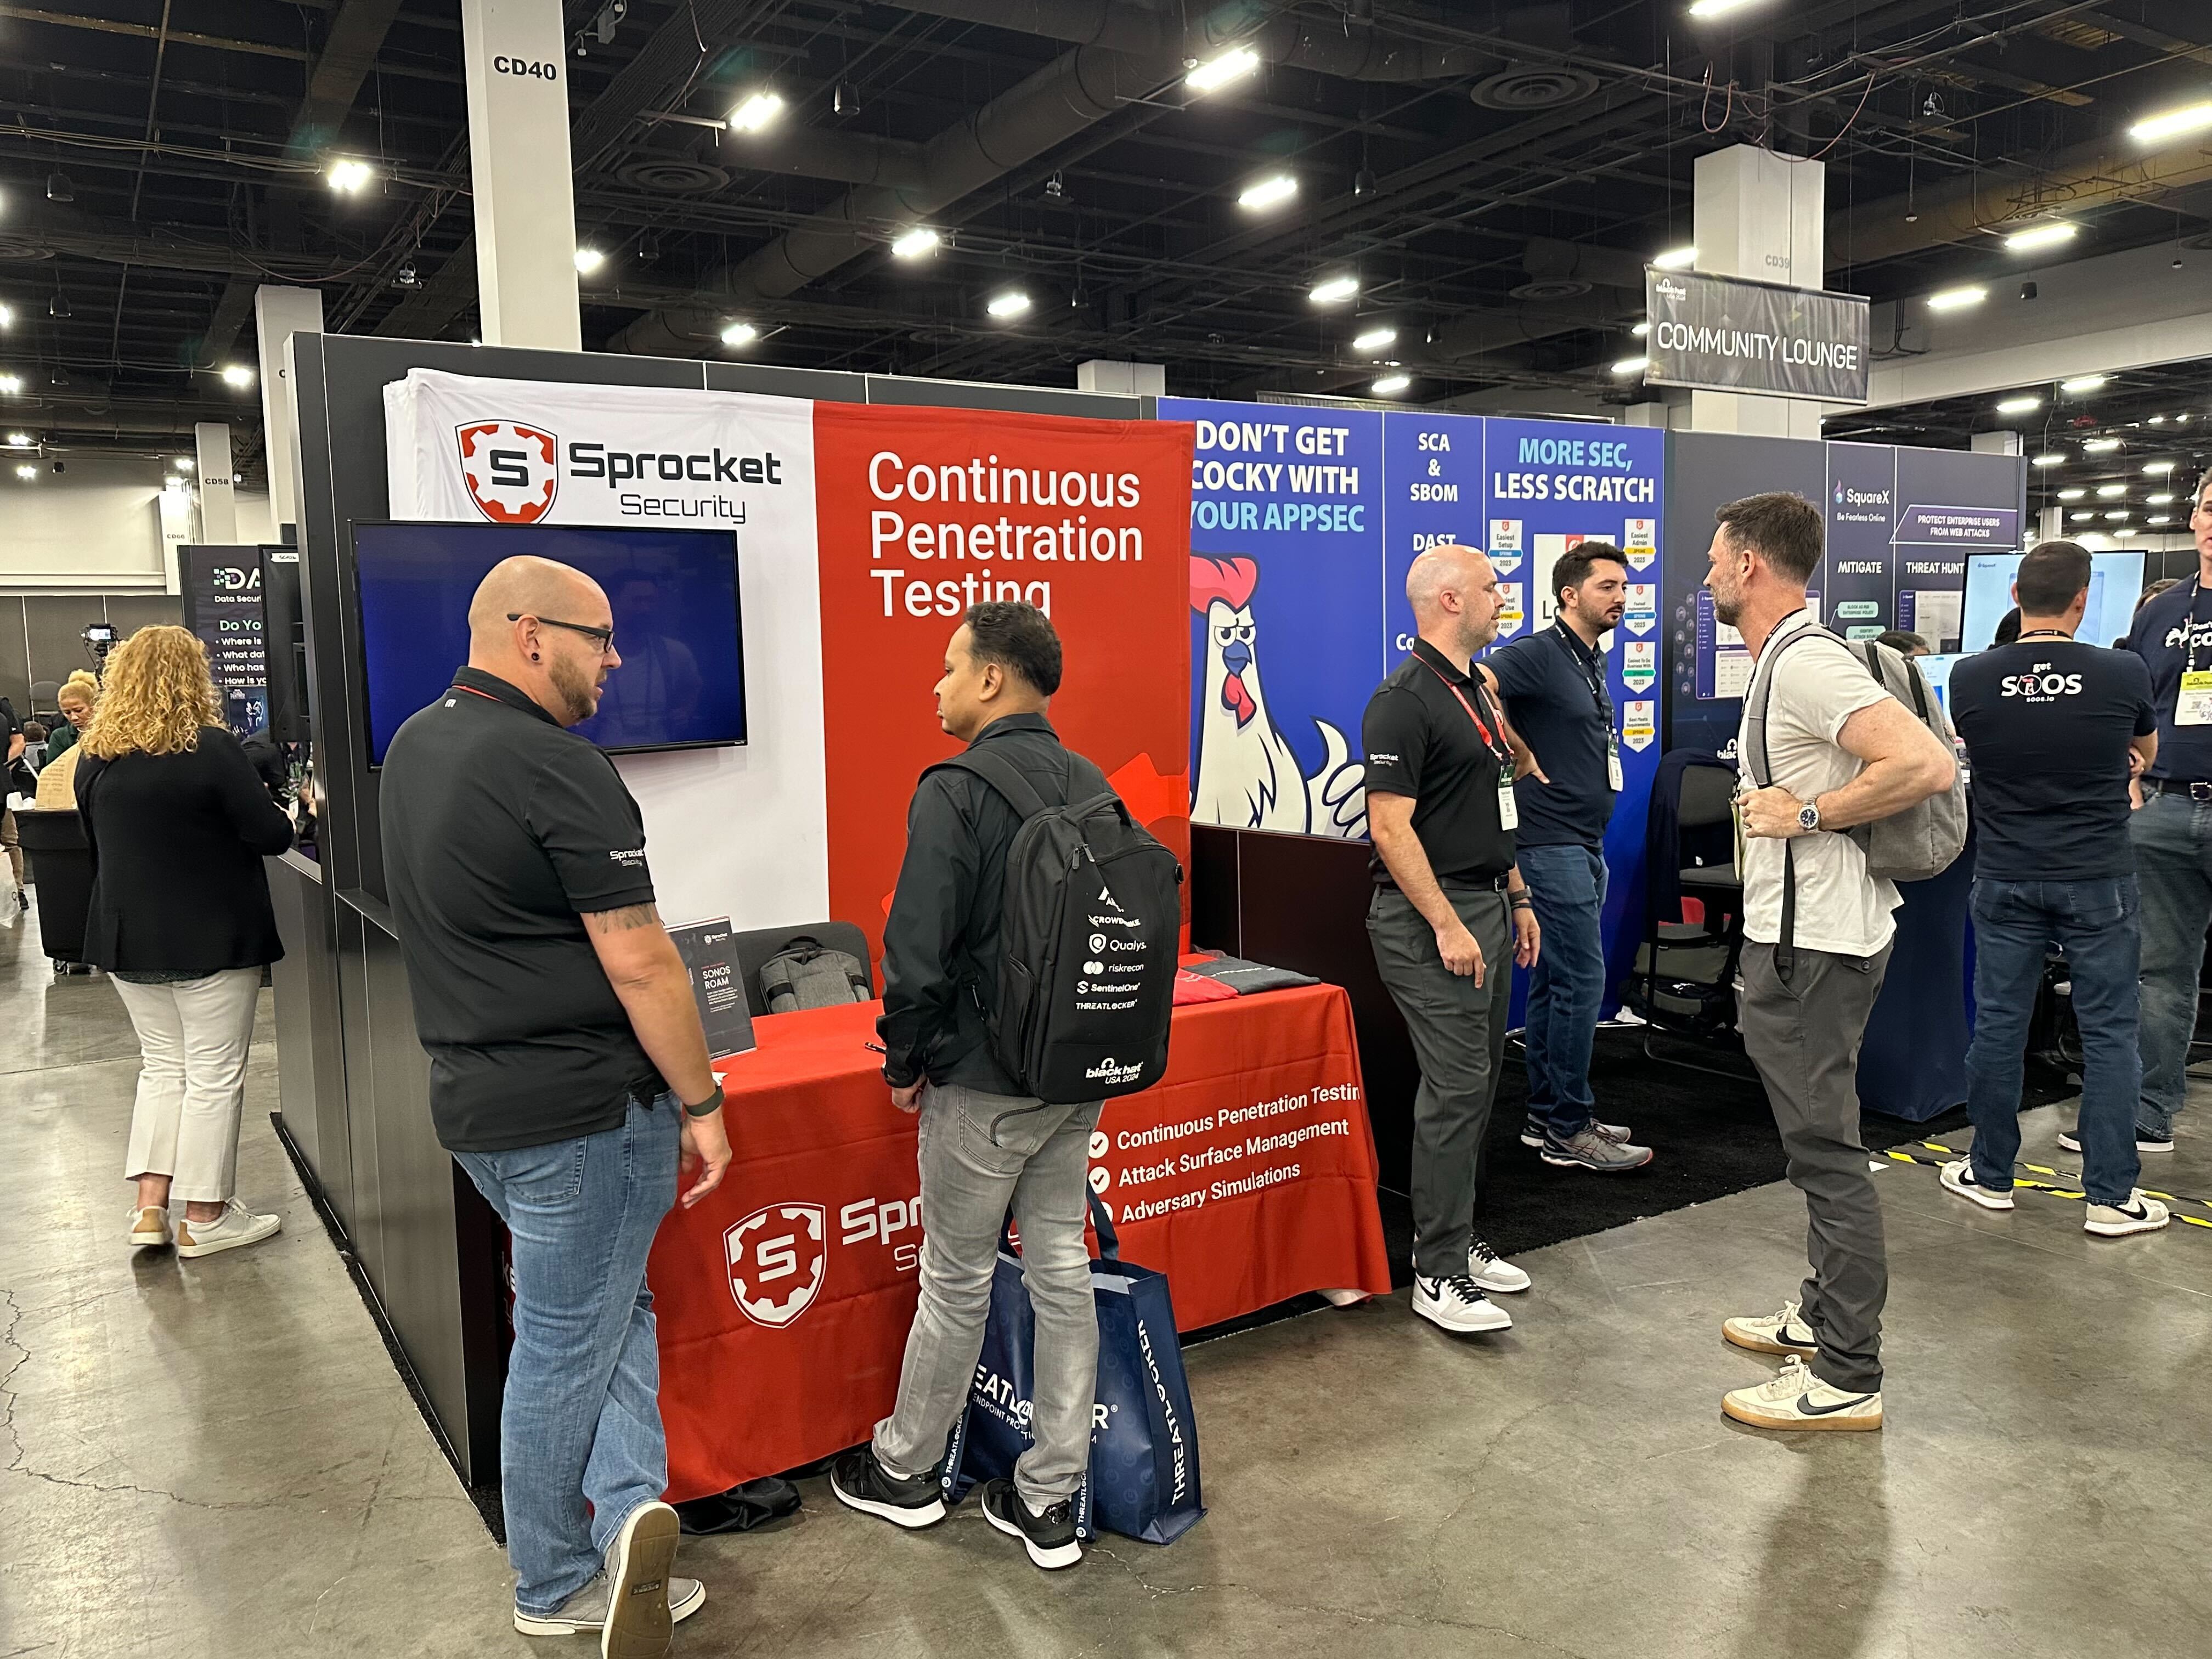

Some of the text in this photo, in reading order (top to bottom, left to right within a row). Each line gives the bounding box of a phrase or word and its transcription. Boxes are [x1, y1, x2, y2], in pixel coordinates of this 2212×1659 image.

[493, 55, 557, 81] CD40
[1765, 255, 1790, 269] CD39
[1657, 321, 1858, 370] COMMUNITY LOUNGE
[1197, 420, 1349, 455] DON'T GET
[1418, 433, 1451, 452] SCA
[1519, 438, 1633, 472] MORE SEC,
[569, 442, 782, 488] Sprocket
[1428, 459, 1441, 476] &
[869, 451, 1140, 508] Continuous
[1191, 460, 1358, 494] COCKY WITH
[1410, 483, 1458, 502] SBOM
[1494, 472, 1654, 503] LESS SCRATCH
[1847, 488, 1889, 507] SquareX
[620, 494, 746, 524] Security
[1263, 503, 1364, 532] APPSEC
[1837, 512, 1886, 522] Be Fearless Online
[1918, 515, 2000, 527] PROTECT ENTERPRISE USERS
[871, 510, 1143, 561] Penetration
[1930, 527, 1990, 538] FROM WEB ATTACKS
[1413, 534, 1456, 551] DAST
[1837, 562, 1882, 574] MITIGATE
[1906, 562, 1965, 574] THREAT HUNT
[870, 568, 1050, 619] Testing
[219, 620, 240, 631] Do
[254, 636, 262, 645] is
[247, 663, 264, 672] has
[2033, 662, 2052, 673] get
[702, 966, 731, 979] SONOS
[1108, 963, 1144, 973] riskrecon
[704, 976, 729, 990] ROAM
[1086, 1063, 1142, 1078] black hat
[1105, 1073, 1139, 1084] USA 2024
[1116, 1082, 1360, 1150] Continuous Penetration Testin
[1118, 1119, 1349, 1188] Attack Surface Management
[1121, 1163, 1301, 1223] Adversary Simulations
[973, 1392, 1006, 1420] ENDPOINT
[1138, 1319, 1184, 1506] THREATLOCKER
